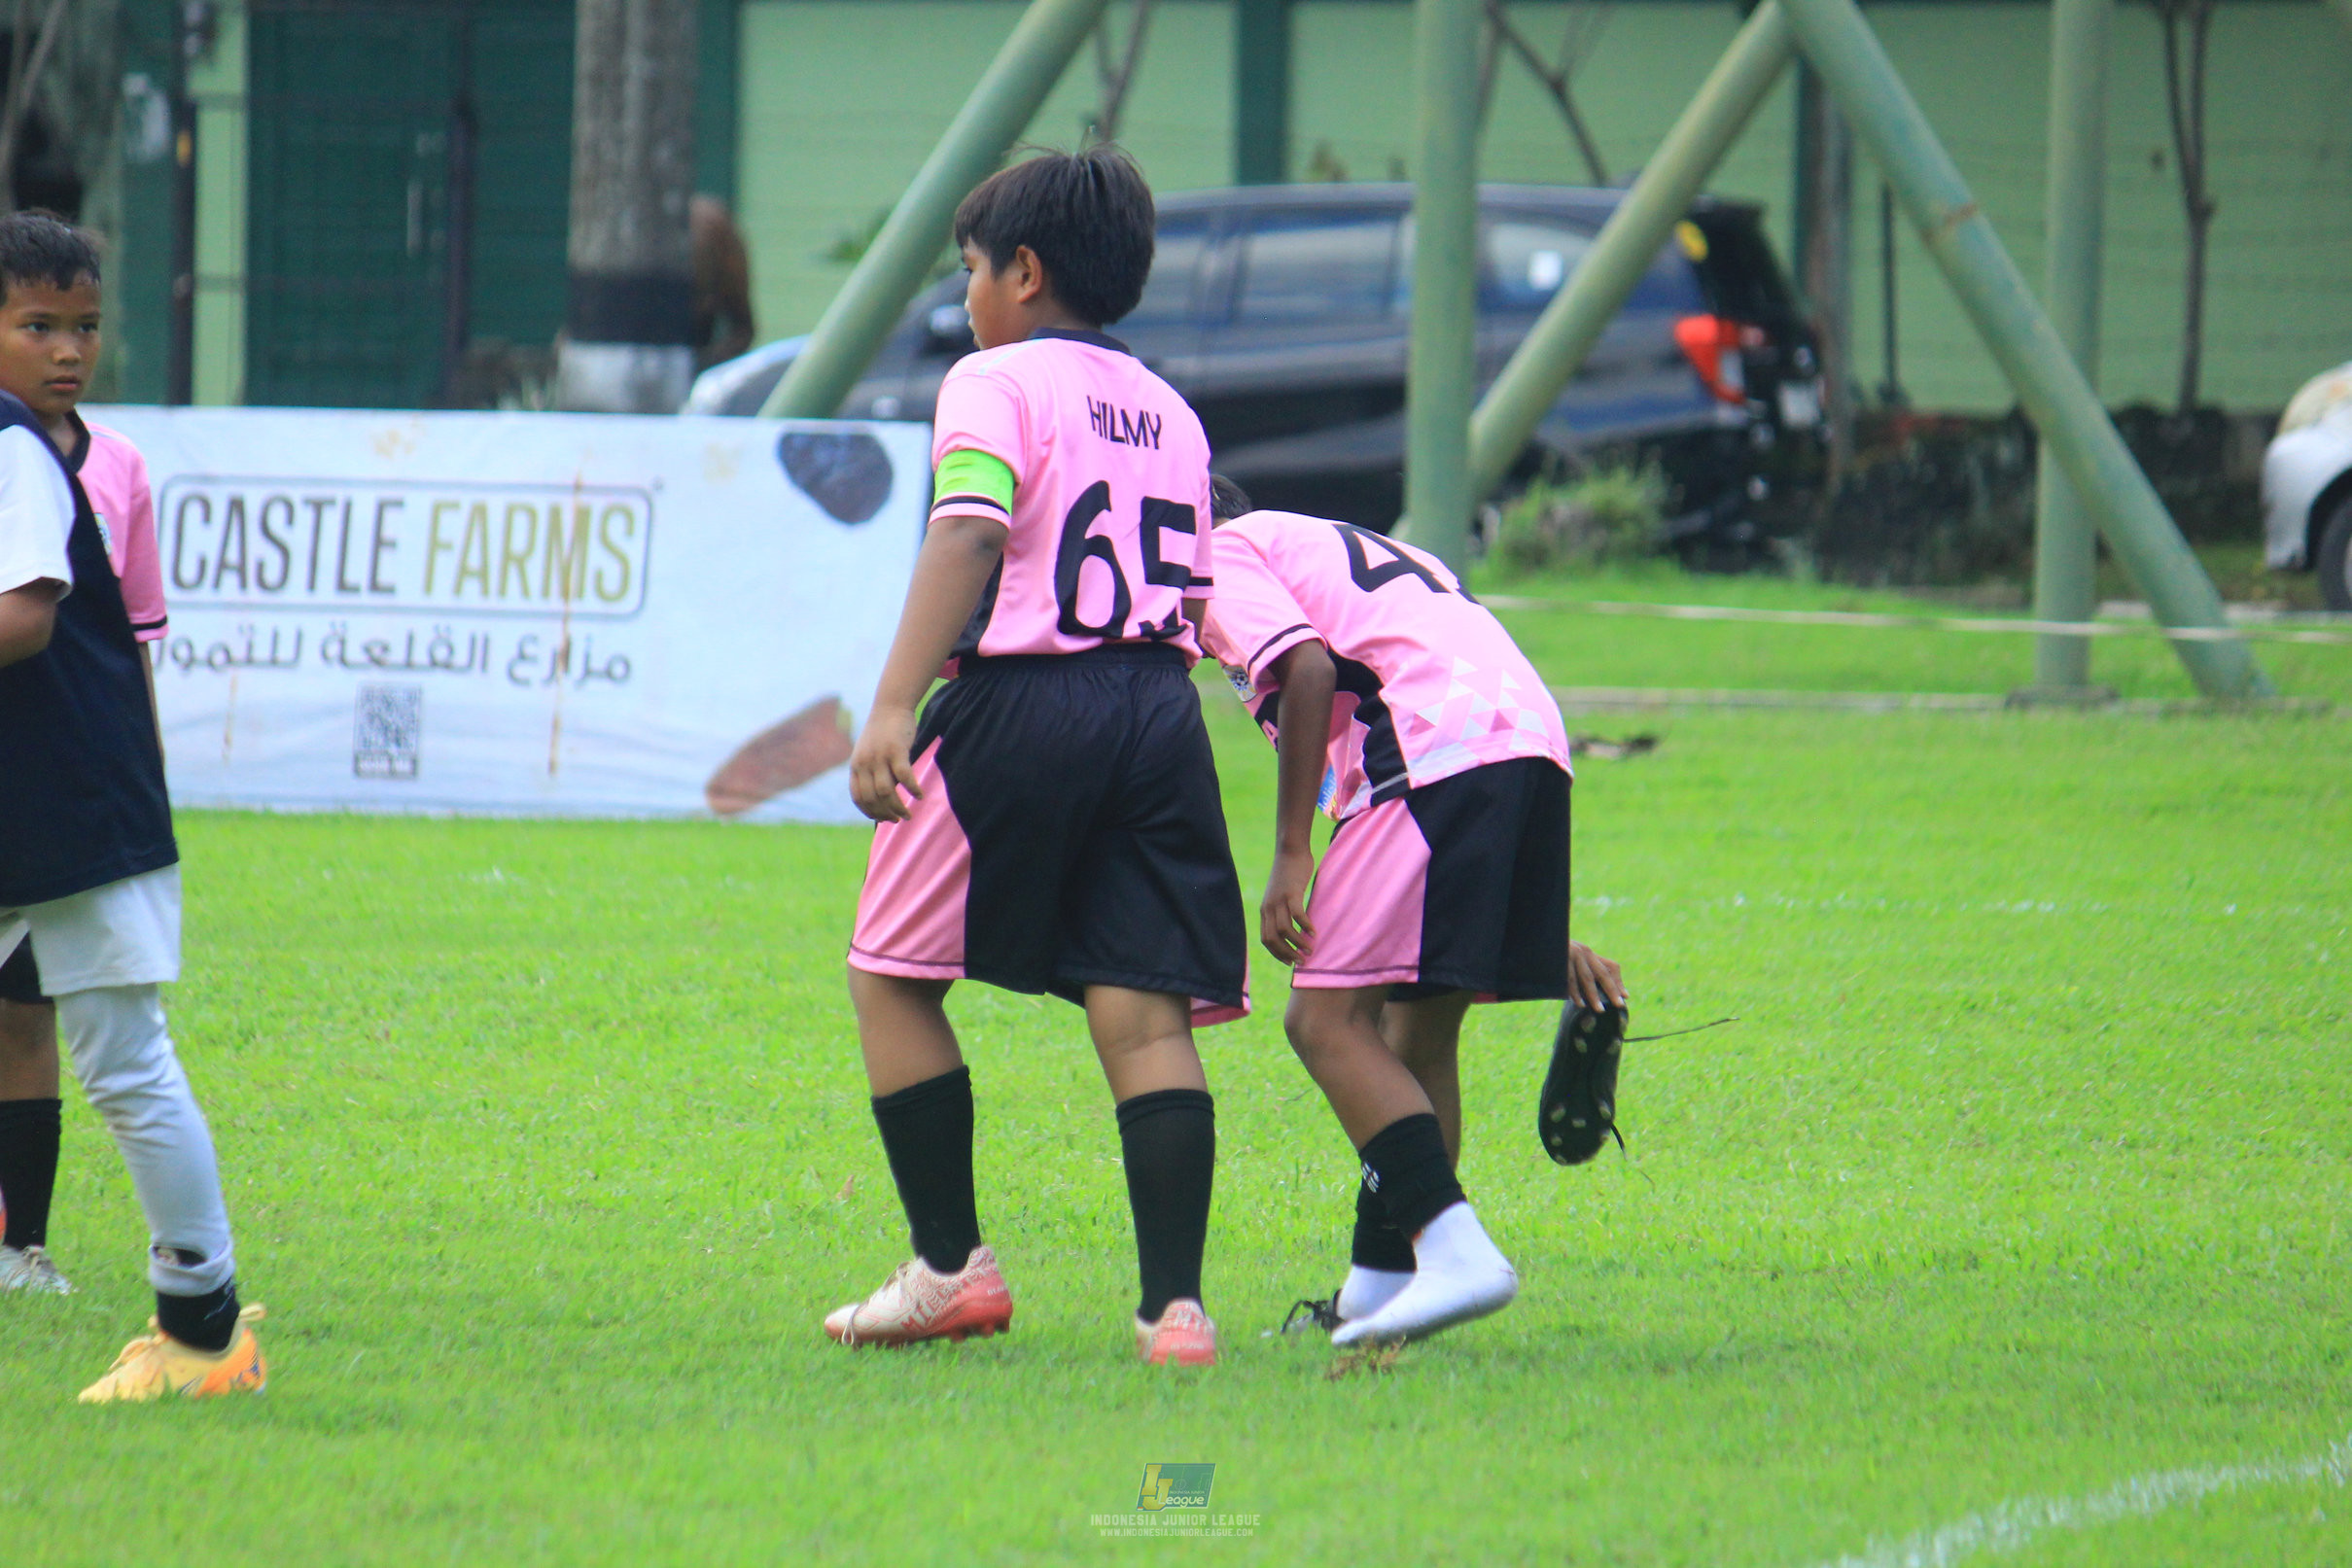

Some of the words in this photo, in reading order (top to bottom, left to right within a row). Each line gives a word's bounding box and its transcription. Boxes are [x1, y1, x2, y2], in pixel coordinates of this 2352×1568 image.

[1087, 395, 1162, 450] HILMY
[172, 494, 404, 593] CASTLE
[424, 500, 636, 604] FARMS
[1054, 479, 1197, 642] 65
[1331, 523, 1480, 605] 4
[321, 621, 487, 673] القلعة
[509, 634, 631, 686] مزارع
